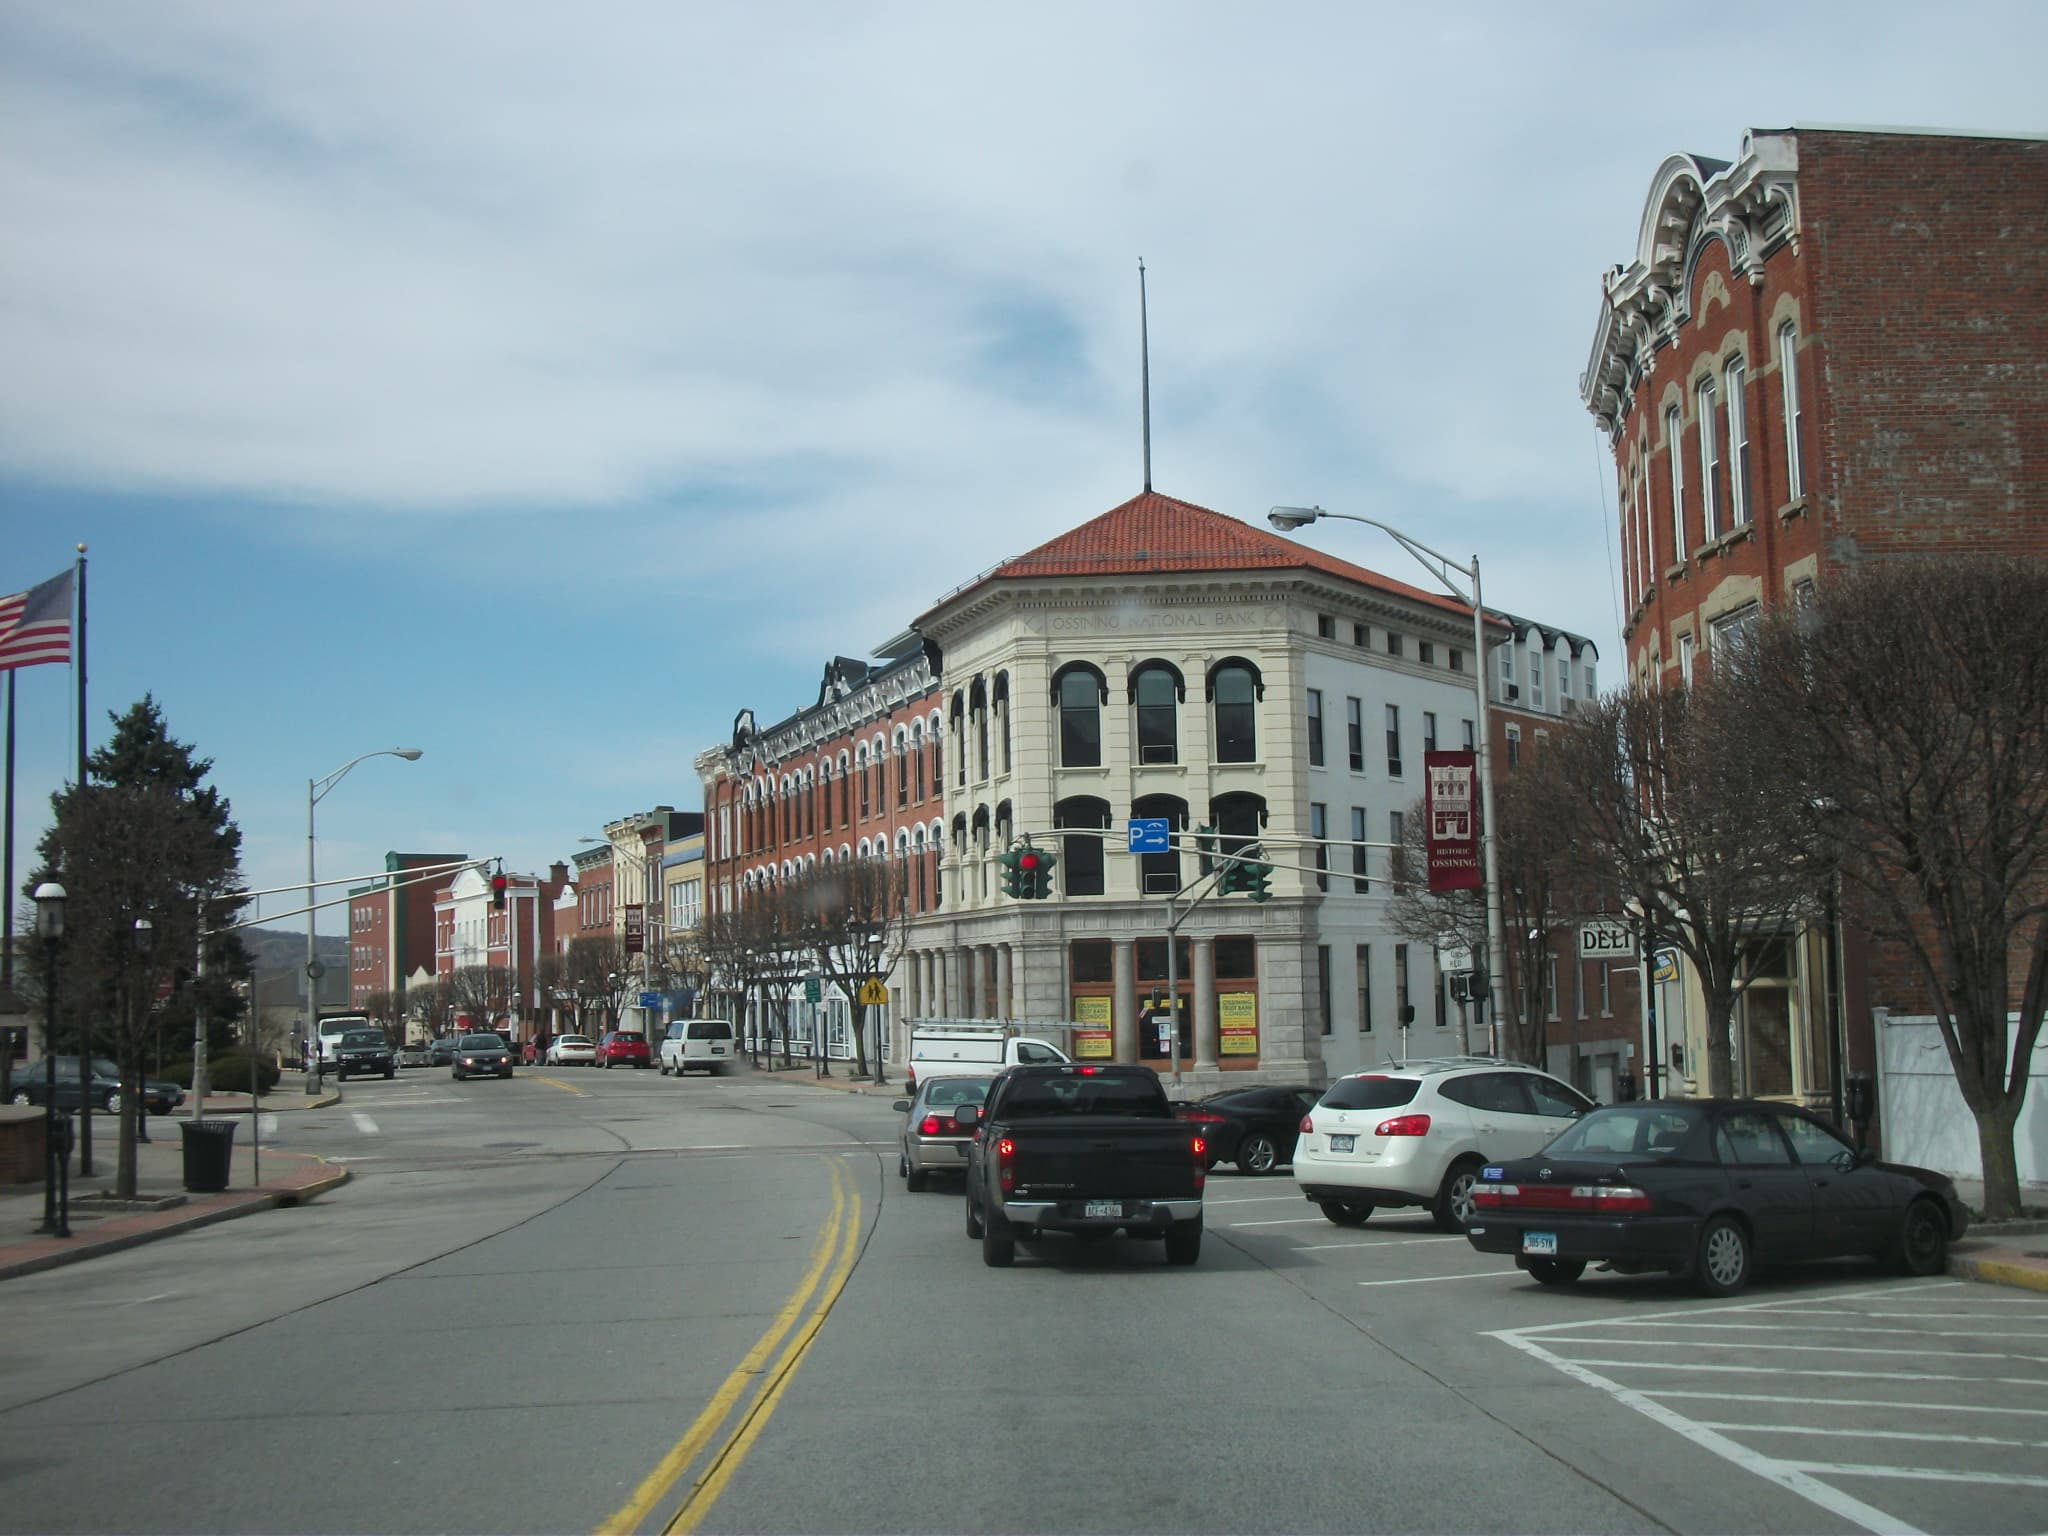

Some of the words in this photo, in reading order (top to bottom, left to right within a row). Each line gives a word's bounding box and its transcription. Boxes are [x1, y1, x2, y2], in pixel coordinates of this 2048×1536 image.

[1052, 615, 1120, 631] OSSINING
[1128, 612, 1207, 630] NATIONAL
[1215, 609, 1257, 626] BANK
[1130, 827, 1144, 846] P
[1436, 848, 1471, 856] HISTORIC
[1432, 858, 1477, 867] OSSINING
[1582, 930, 1630, 949] DELI
